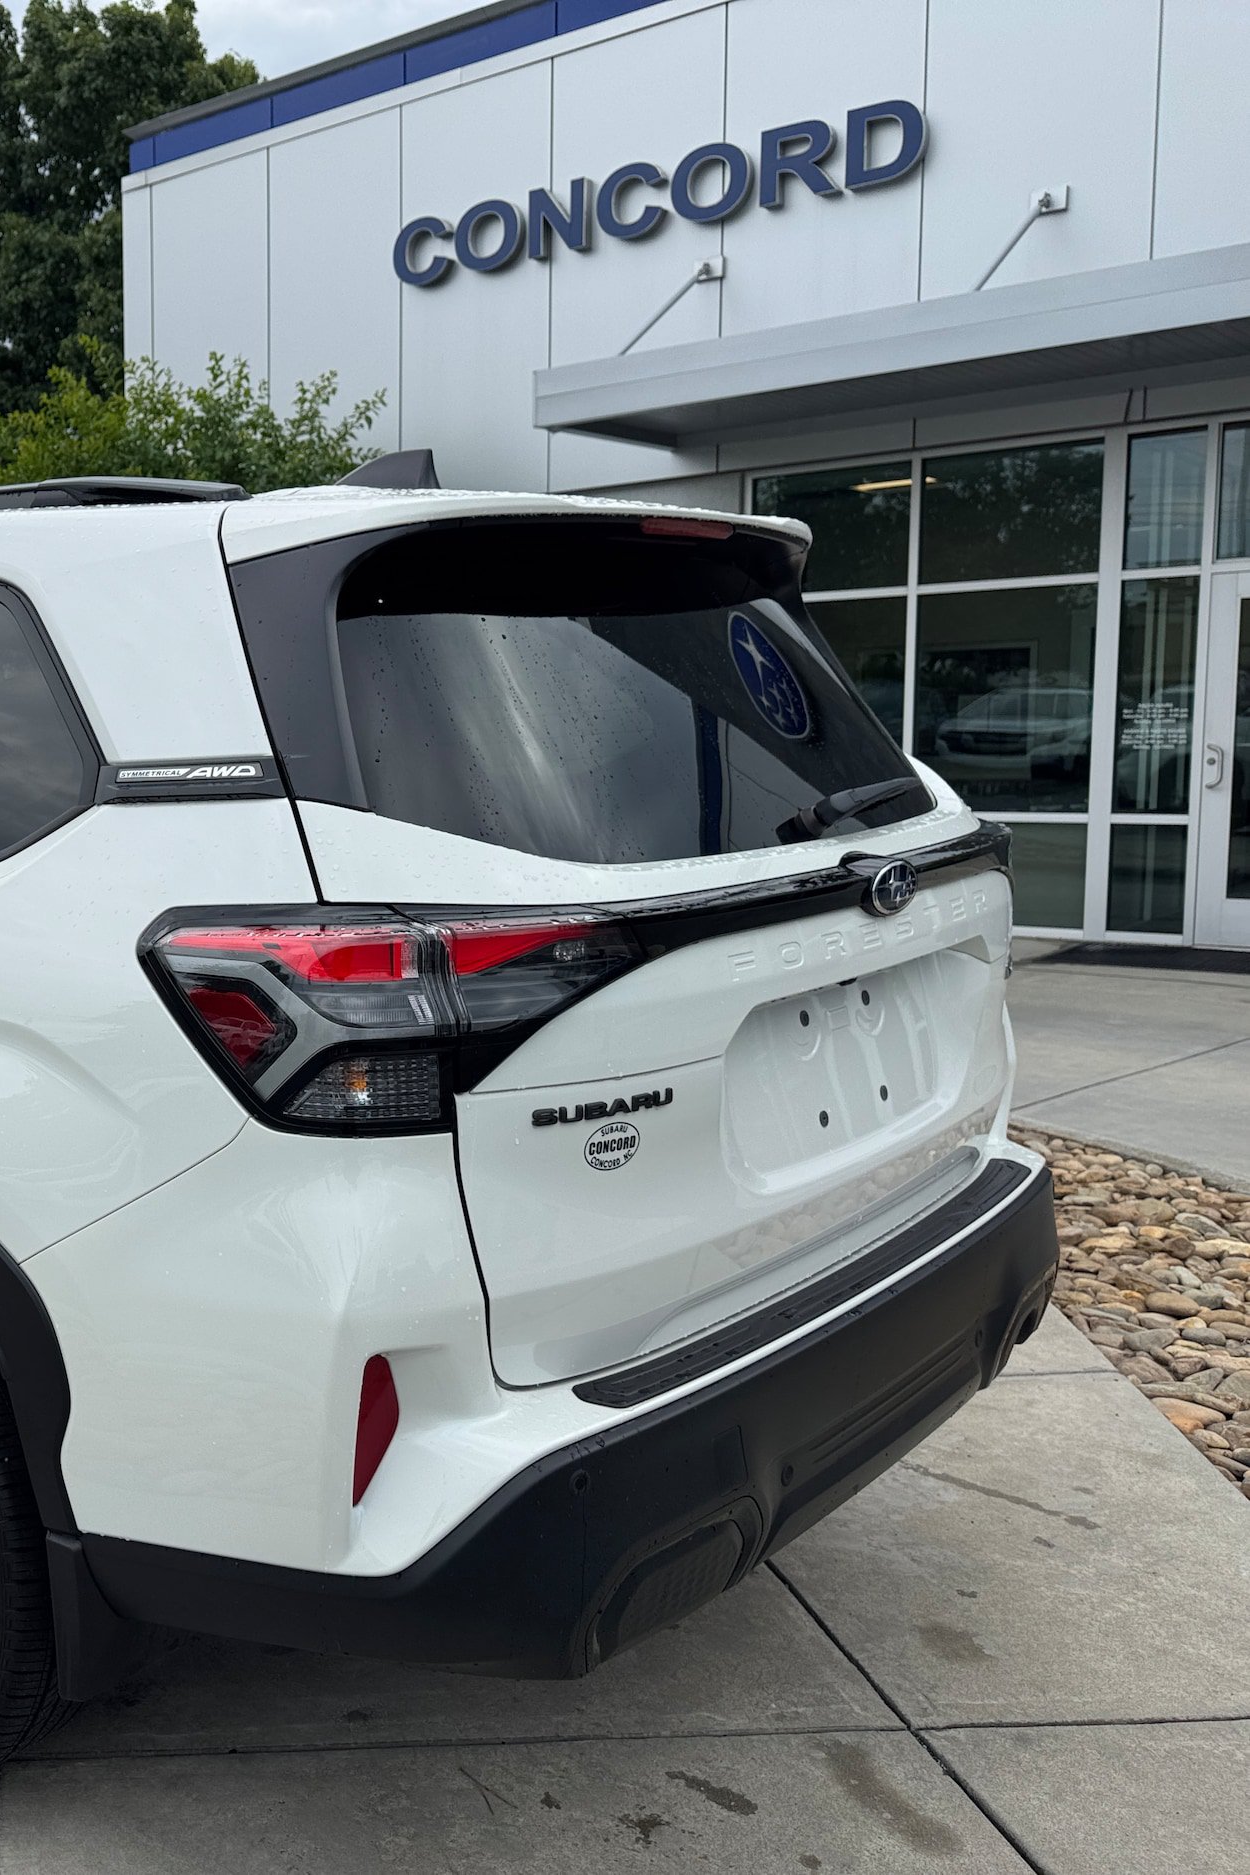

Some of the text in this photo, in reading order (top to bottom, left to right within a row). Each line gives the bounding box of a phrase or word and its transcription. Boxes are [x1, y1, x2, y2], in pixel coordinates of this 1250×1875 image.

[392, 99, 929, 288] CONCORD
[121, 764, 256, 779] SYMMETRICAL AWD
[728, 889, 989, 983] FORESTER
[531, 1087, 674, 1127] SUBARU
[600, 1124, 629, 1137] SUBARU
[588, 1135, 636, 1155] CONCORD
[590, 1149, 634, 1169] CONCORD NC
